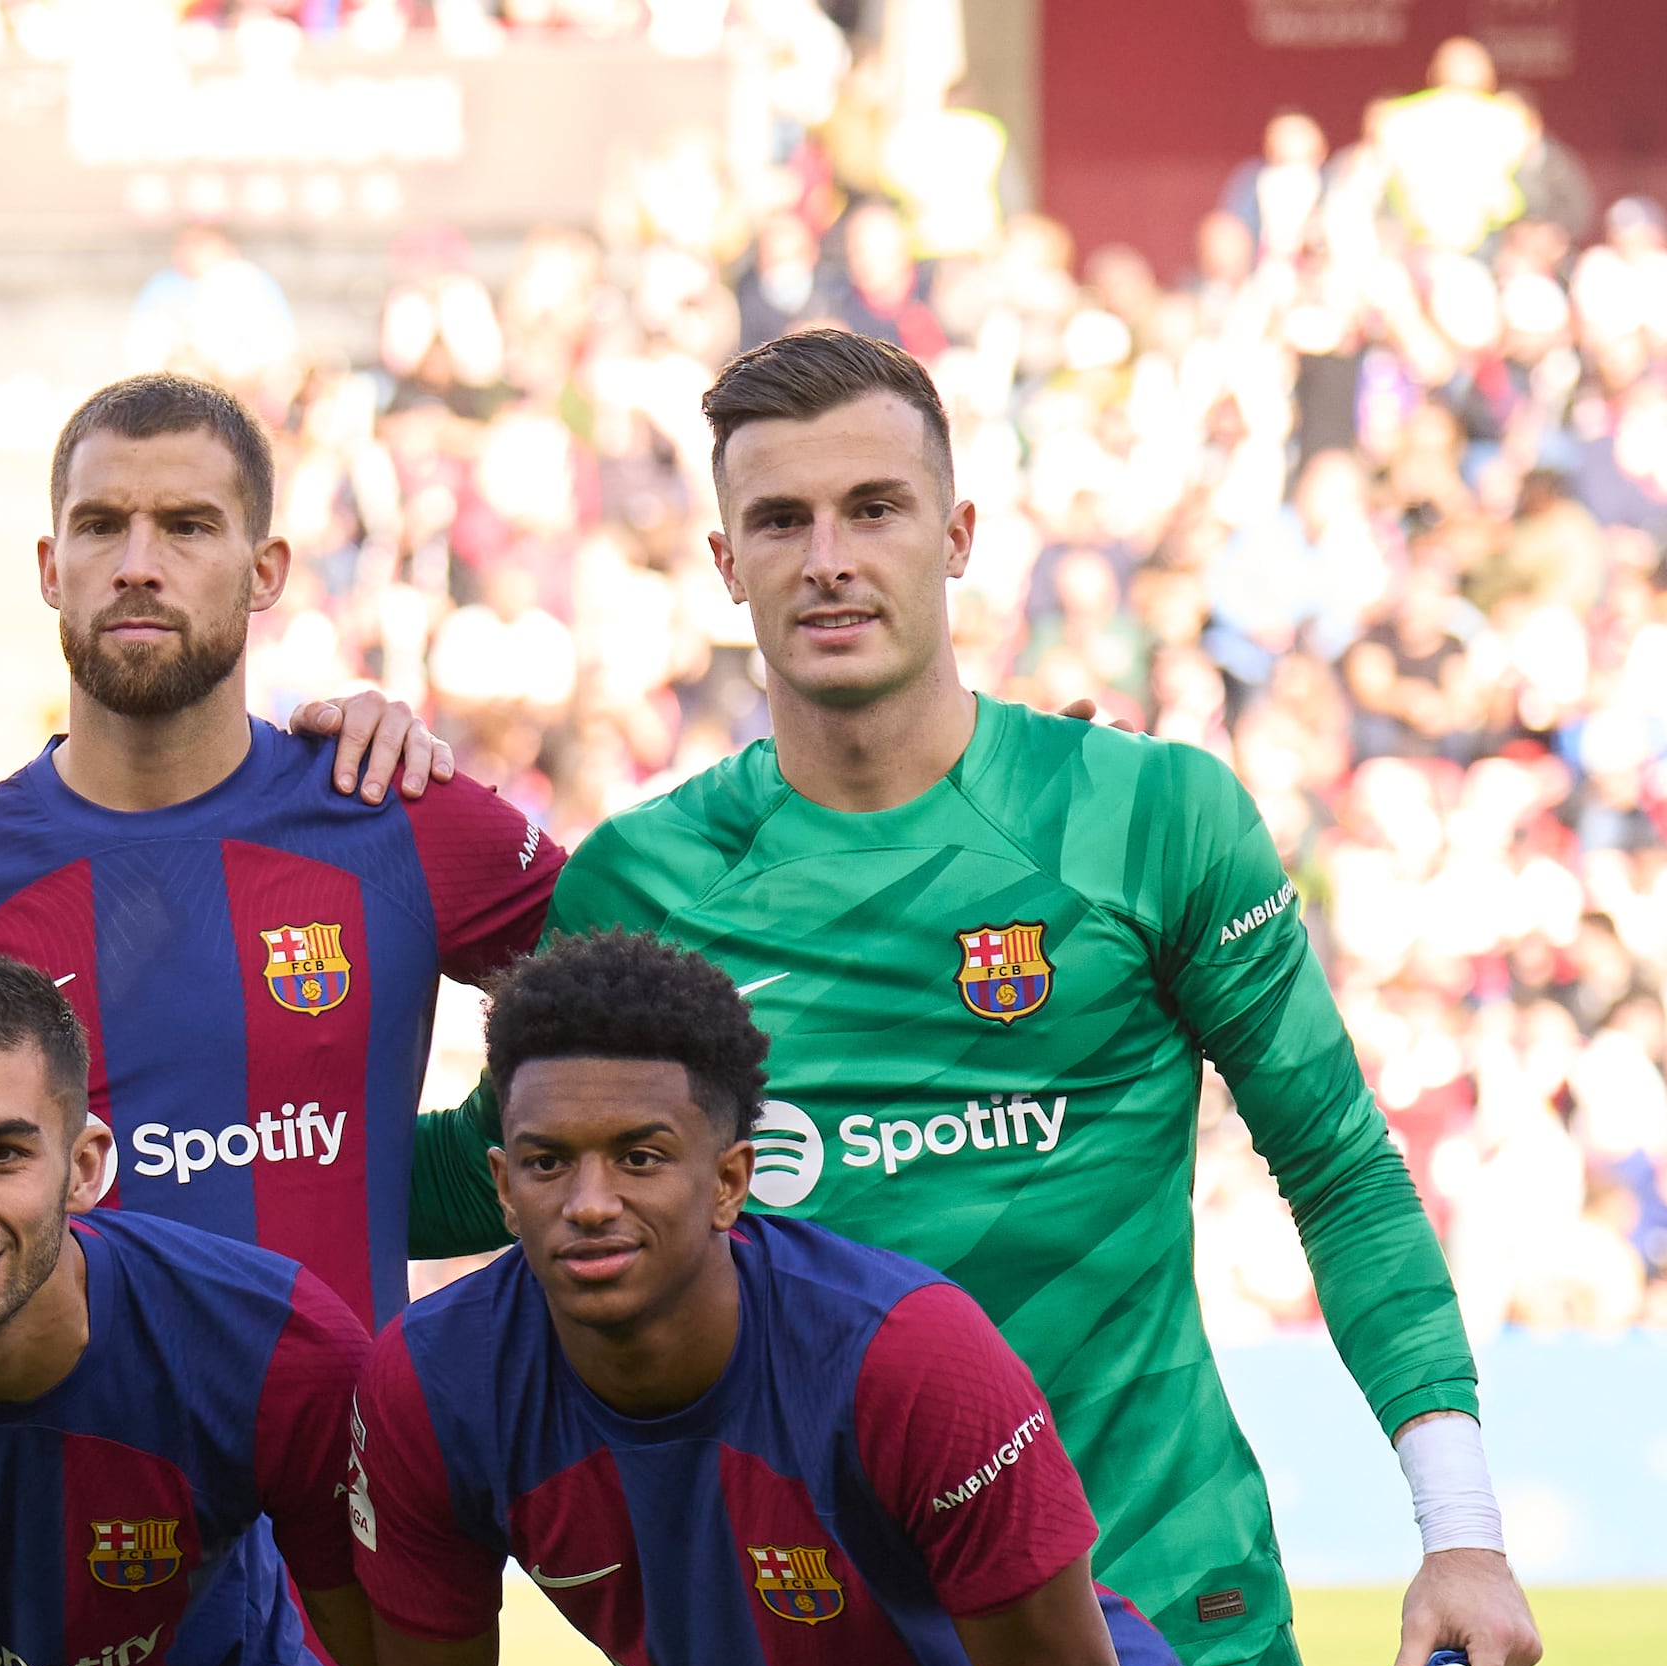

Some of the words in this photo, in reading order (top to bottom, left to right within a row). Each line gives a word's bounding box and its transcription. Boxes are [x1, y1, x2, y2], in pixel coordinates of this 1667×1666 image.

[291, 960, 325, 974] FCB
[987, 965, 1022, 979] FCB
[838, 1092, 1068, 1175] Spotify
[132, 1101, 347, 1184] Spotify
[116, 1550, 154, 1560] FCB
[780, 1579, 815, 1589] FCB
